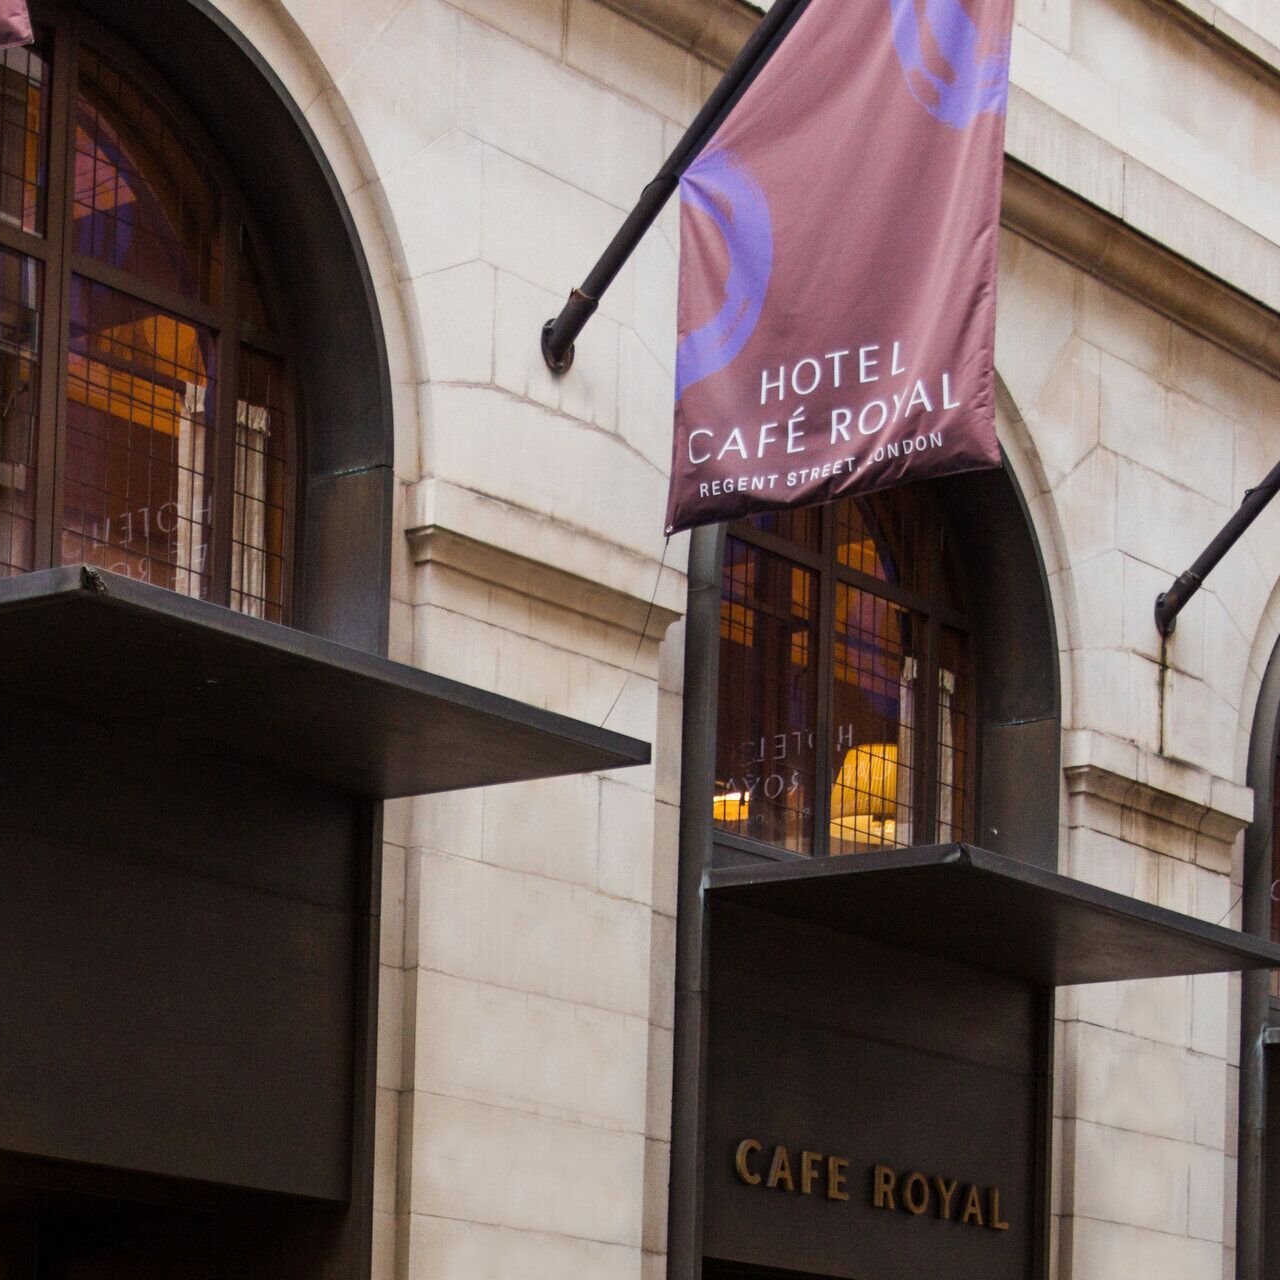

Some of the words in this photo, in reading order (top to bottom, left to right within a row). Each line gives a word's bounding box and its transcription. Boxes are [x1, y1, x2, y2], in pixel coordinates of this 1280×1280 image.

[760, 341, 906, 405] HOTEL
[688, 406, 806, 464] CAFÉ
[830, 373, 961, 445] ROYAL
[699, 475, 779, 498] REGENT
[786, 456, 862, 487] STREET,
[735, 1139, 850, 1201] CAFE
[873, 1164, 1010, 1230] ROYAL
